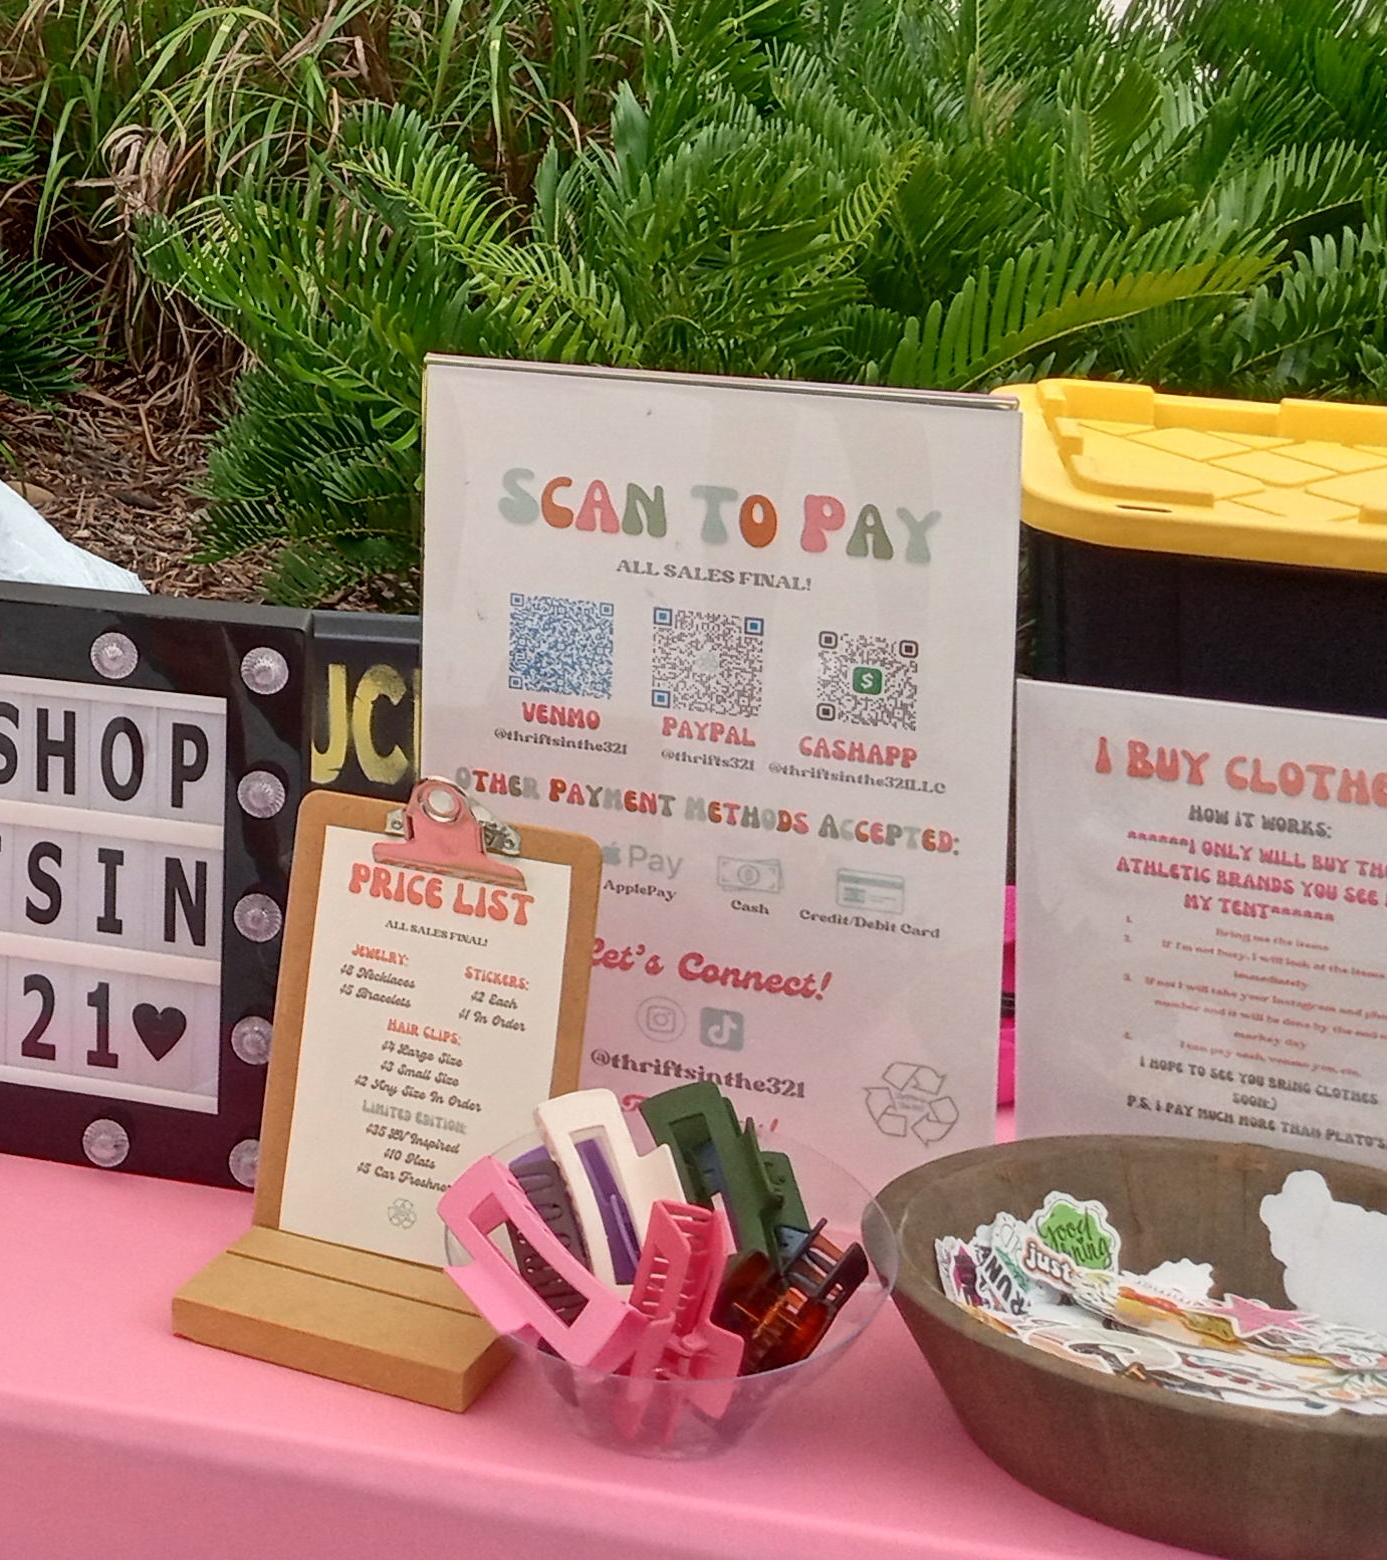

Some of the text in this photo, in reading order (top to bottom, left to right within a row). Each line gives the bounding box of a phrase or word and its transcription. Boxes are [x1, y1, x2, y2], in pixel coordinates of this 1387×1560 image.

[498, 467, 942, 564] SCAN TO PAY
[616, 559, 813, 592] ALL SALES FINAL!
[521, 700, 601, 731] VENMO
[661, 715, 756, 748] PAYPAL
[493, 727, 628, 756] @thriftsinthe321
[798, 734, 918, 770] CASHAPP
[660, 748, 756, 772] @thrifts321
[1094, 736, 1112, 774] I
[1127, 739, 1210, 786] BUY
[768, 761, 947, 795] @thriftsinthe321LLC
[455, 766, 961, 857] OTHER PAYMENT METHODS ACCEPTED:
[1188, 804, 1228, 825] HOW
[1261, 814, 1332, 839] WORKS:
[628, 844, 683, 880] Pay
[1202, 840, 1349, 874] ONLY WILL BUY
[348, 862, 535, 926] PRICE LIST
[603, 878, 677, 903] ApplePay
[1116, 856, 1379, 907] ATHLETIC BRANDS YOU SEE
[730, 898, 769, 916] Cash
[1184, 893, 1212, 911] MY
[384, 919, 488, 948] ALL SALES FINAL!
[799, 908, 941, 939] Credit/Debit Card
[351, 943, 409, 967] JEWELRY:
[356, 966, 416, 989] Necklaces
[677, 948, 833, 1001] Connect!
[339, 983, 412, 1008] $5 Bracelets
[470, 990, 518, 1010] $2 Each
[473, 1010, 488, 1024] In
[491, 1013, 526, 1033] Order
[397, 1043, 435, 1063] Large
[437, 1052, 464, 1068] Size
[380, 1059, 460, 1088] $3 Small Size
[590, 1047, 806, 1100] @thriftsinthe321
[1150, 1058, 1184, 1074] HOPE
[1188, 1063, 1206, 1077] TO
[1210, 1068, 1234, 1082] SEE
[1239, 1072, 1265, 1087] YOU
[1315, 1084, 1379, 1106] CLOTHES
[354, 1074, 482, 1113] $2 Any Size In Order
[1165, 1101, 1195, 1118] PAY
[1197, 1107, 1234, 1125] MUCH
[1238, 1115, 1276, 1131] MORE
[1280, 1121, 1322, 1139] THAN
[366, 1122, 387, 1138] $35
[410, 1129, 460, 1155] Inspired
[383, 1147, 402, 1161] $10
[356, 1161, 371, 1175] $5
[374, 1165, 396, 1182] Car
[1026, 1241, 1074, 1284] just
